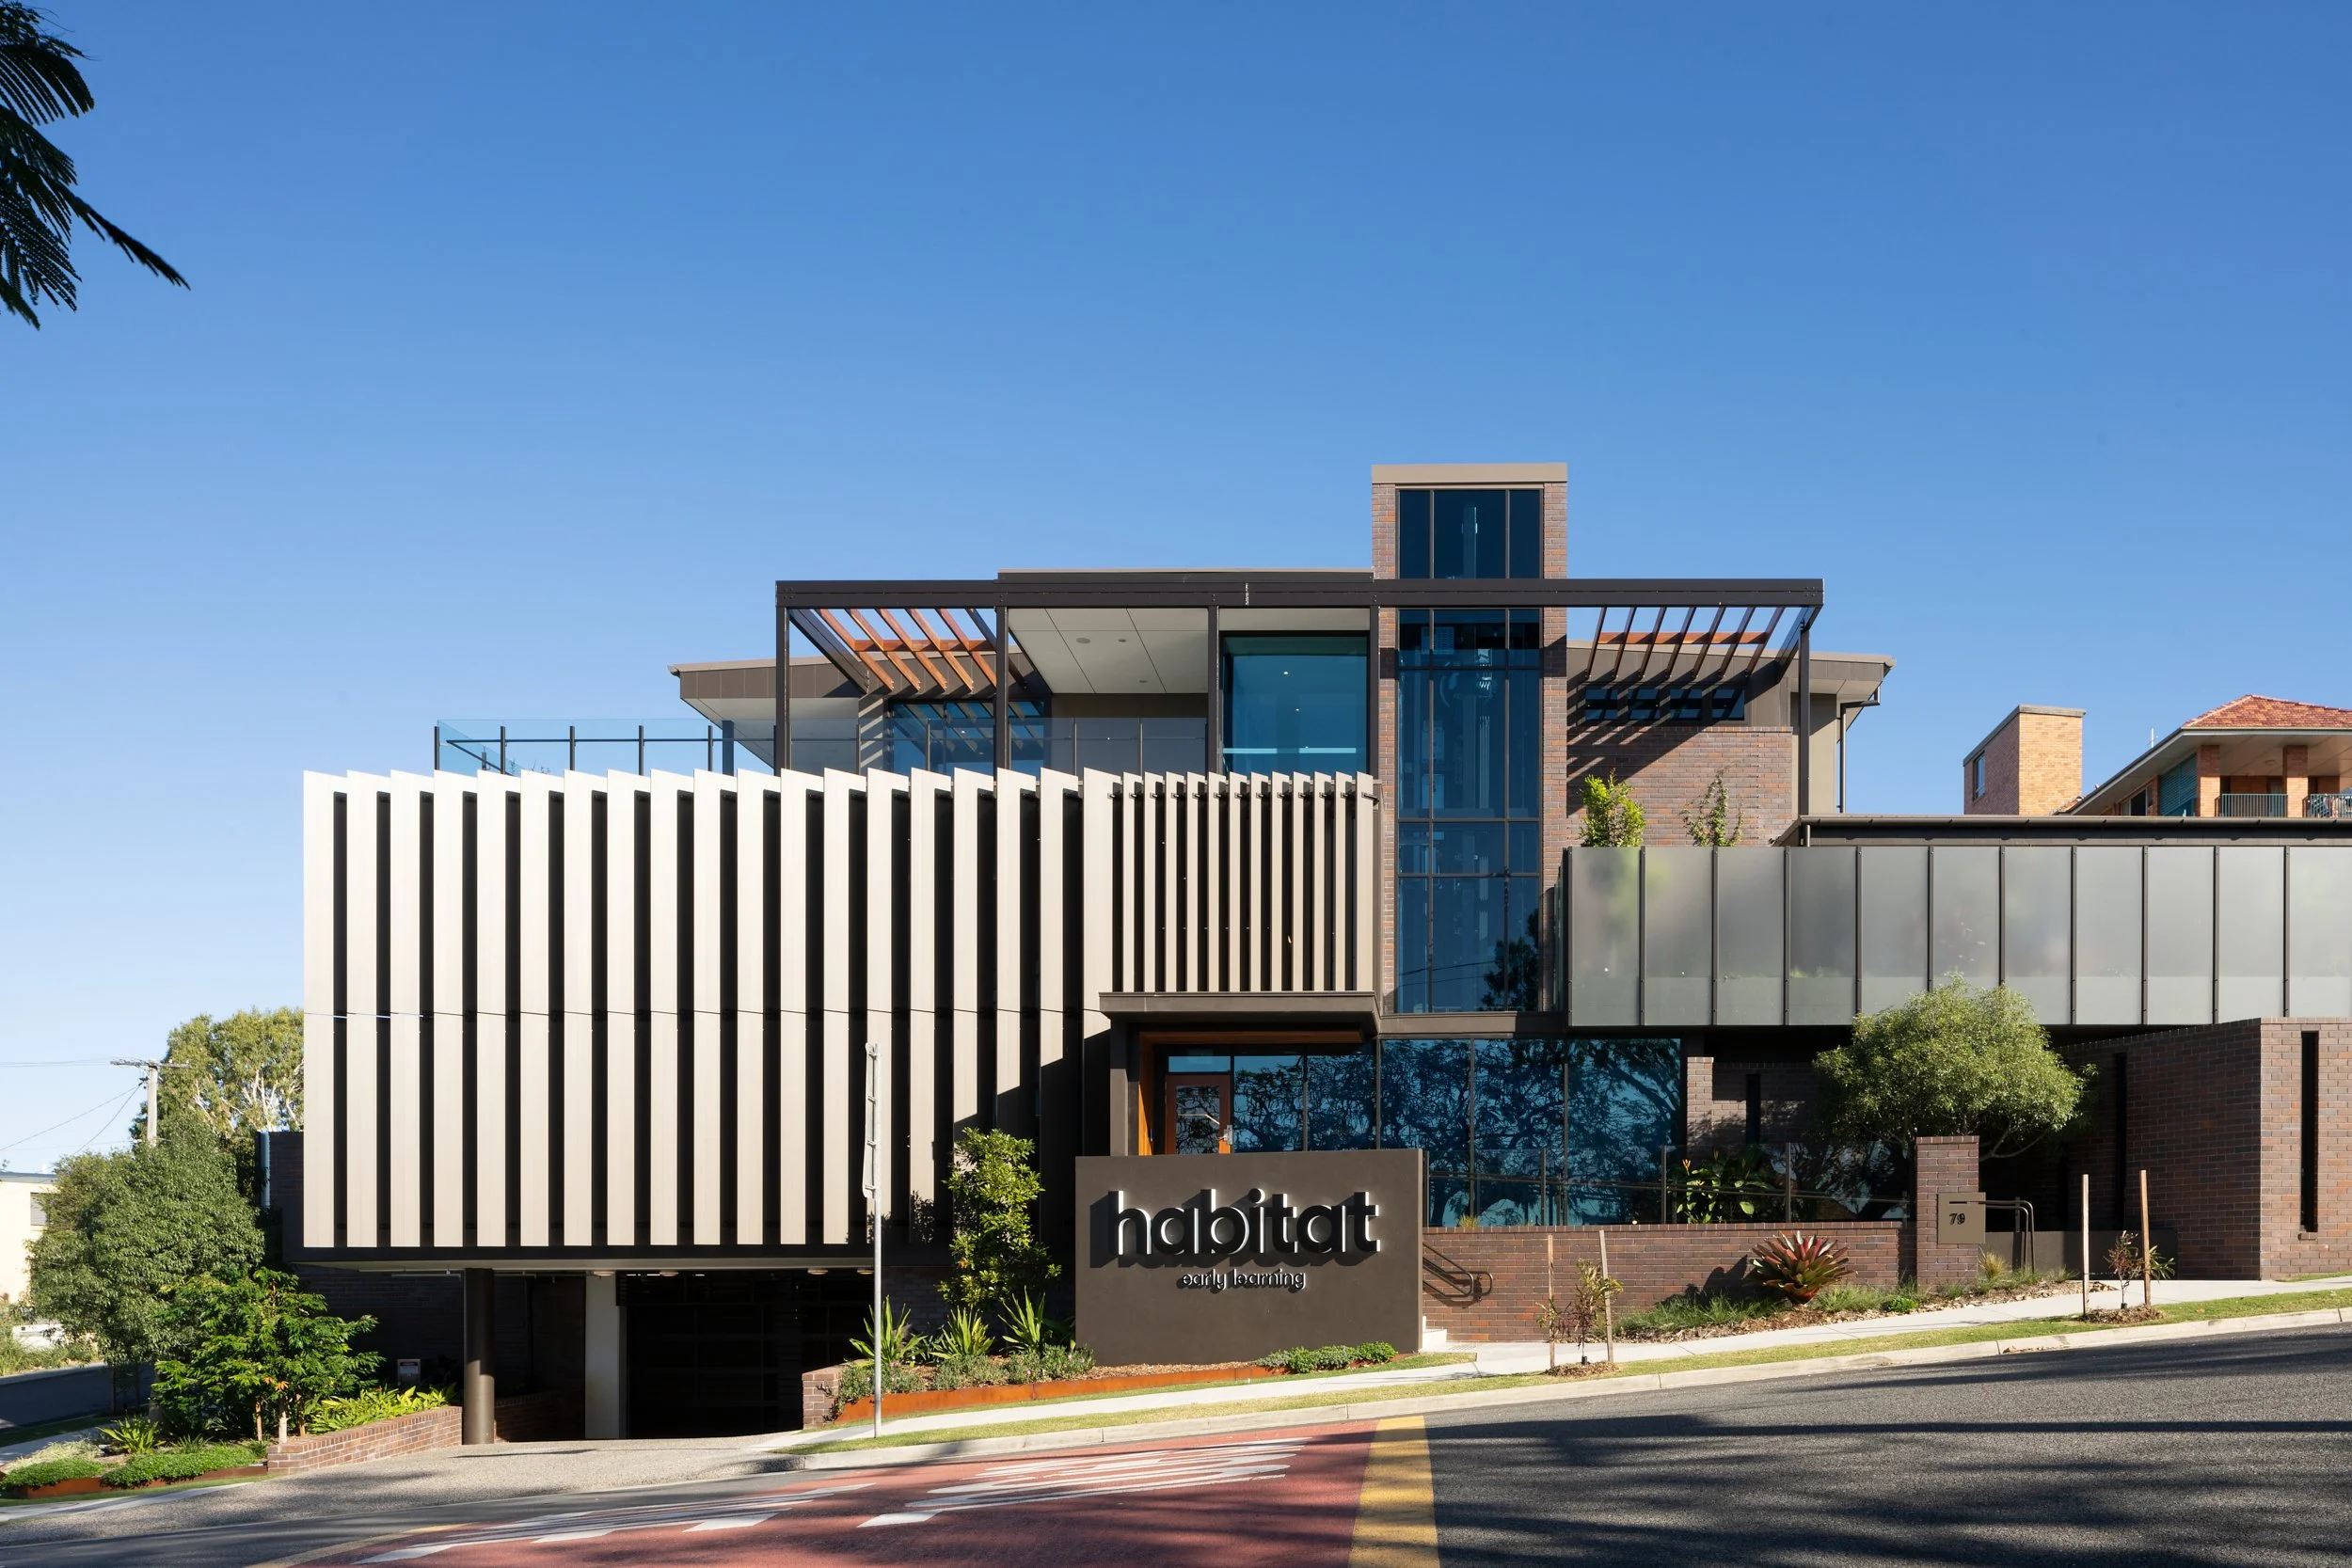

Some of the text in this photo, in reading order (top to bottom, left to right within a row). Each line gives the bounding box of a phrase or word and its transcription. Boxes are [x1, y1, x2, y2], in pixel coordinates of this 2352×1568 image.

[1107, 1188, 1381, 1256] habitat
[1949, 1213, 1966, 1226] 79
[1182, 1267, 1306, 1291] early learning
